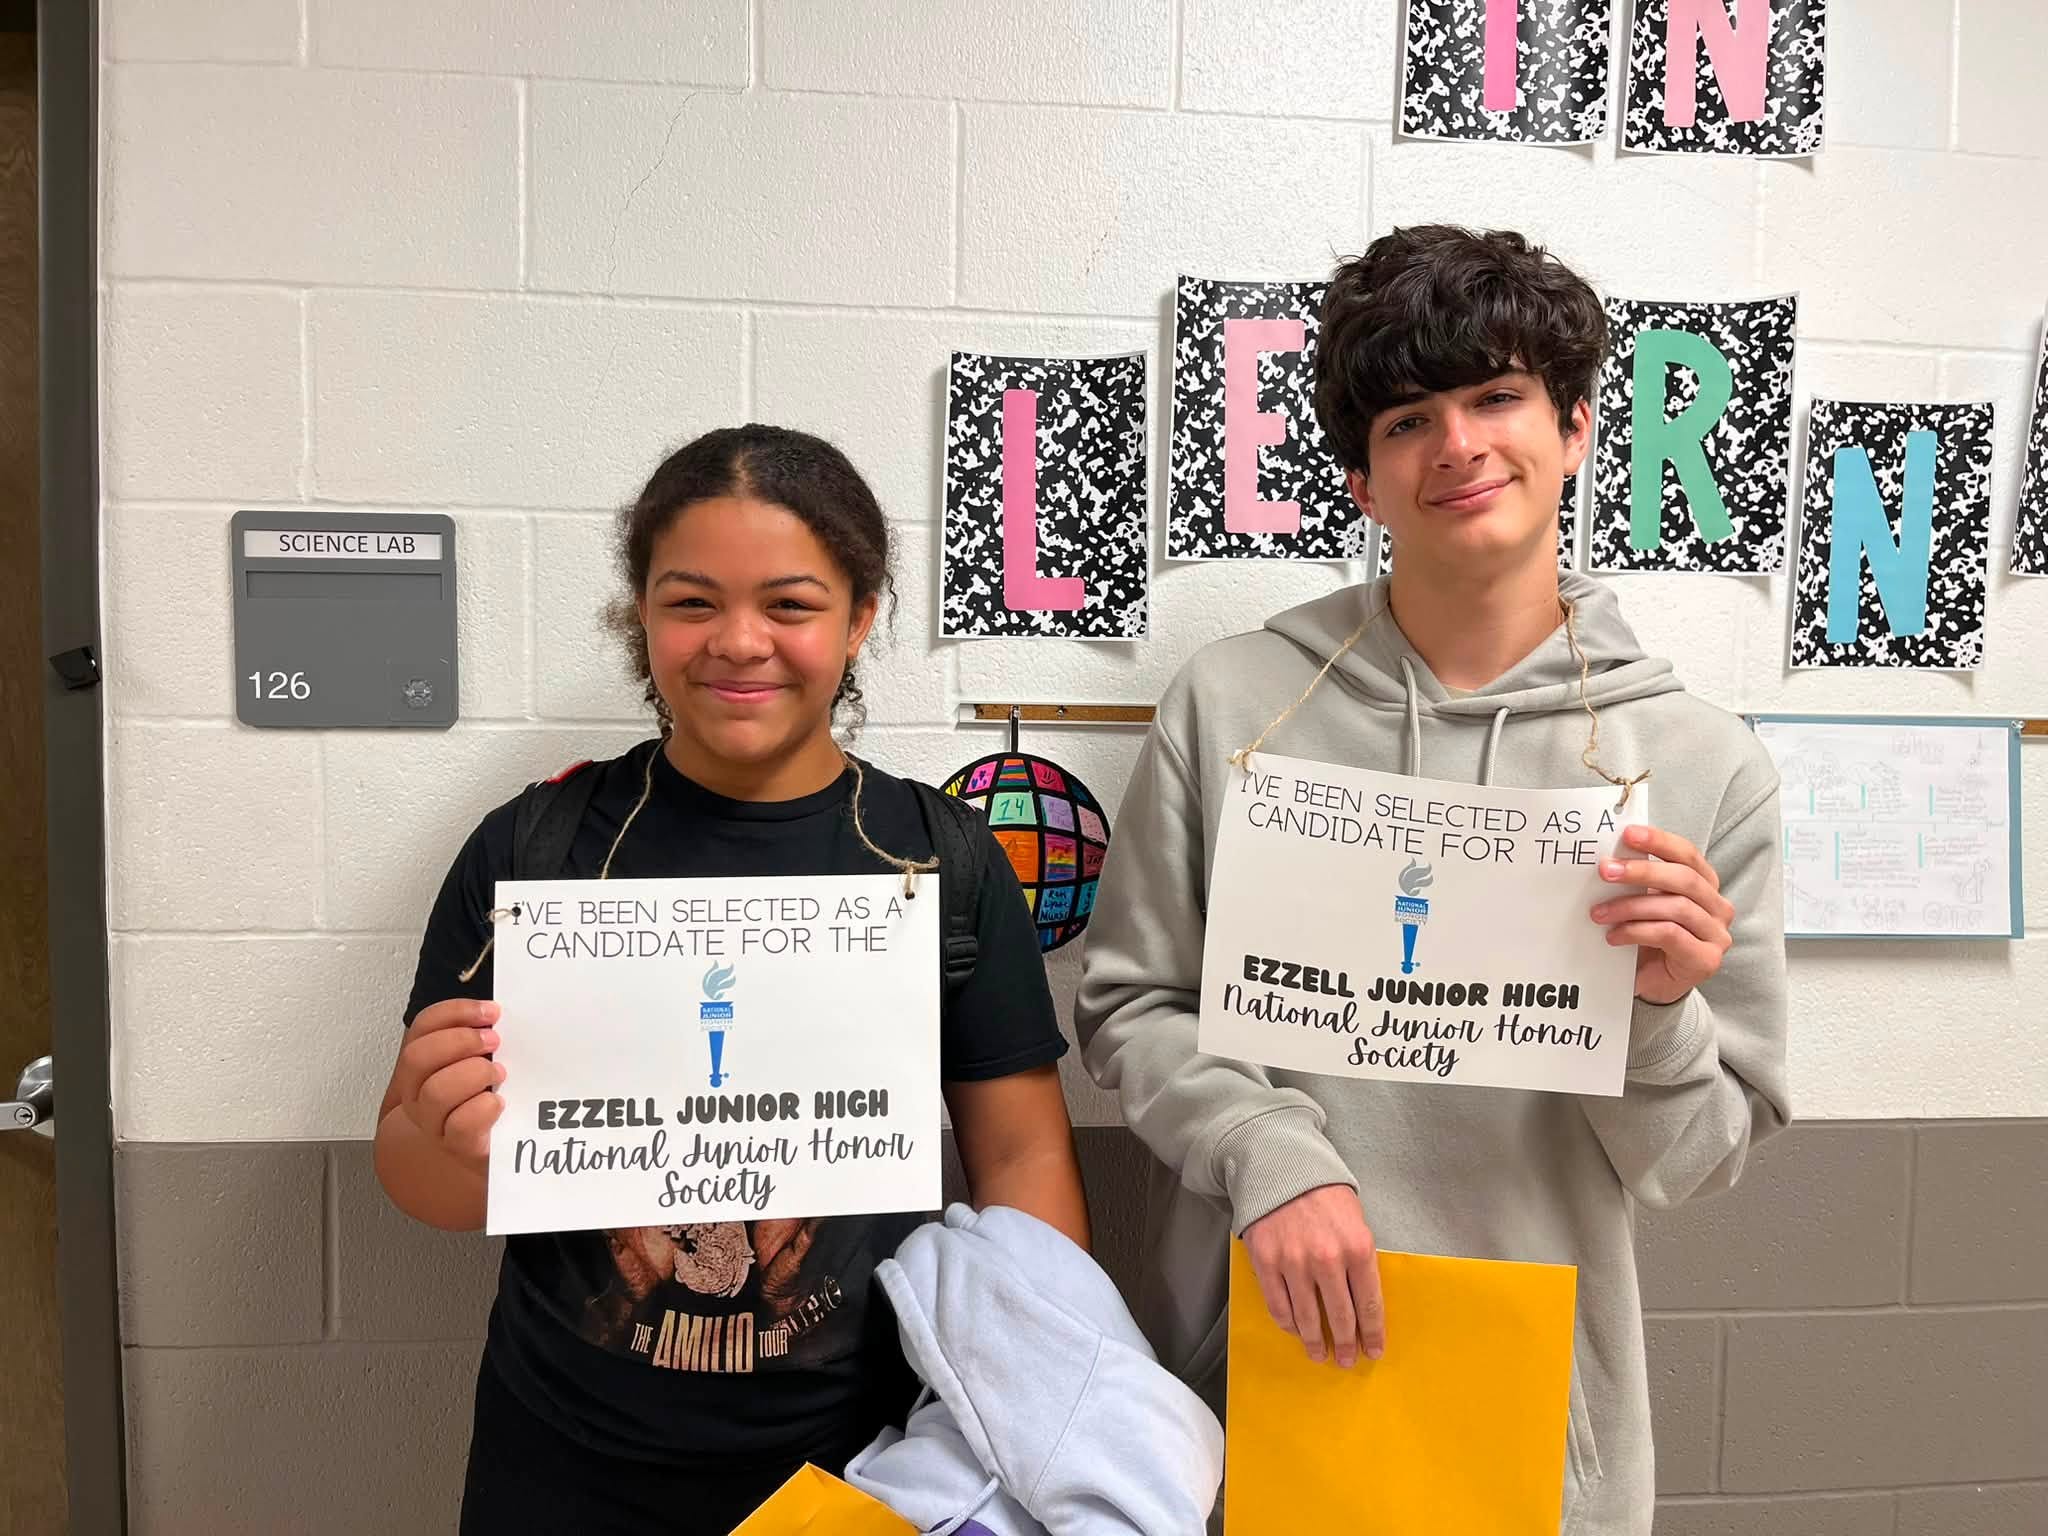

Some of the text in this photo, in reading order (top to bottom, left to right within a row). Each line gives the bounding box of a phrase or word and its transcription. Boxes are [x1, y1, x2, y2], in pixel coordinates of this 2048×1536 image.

[278, 533, 417, 554] SCIENCE LAB
[248, 670, 312, 701] 126
[1294, 779, 1362, 813] BEEN
[1374, 792, 1527, 833] SELECTED
[1543, 810, 1582, 834] AS
[1598, 808, 1615, 833] A
[1247, 802, 1598, 866] CANDIDATE FOR THE
[511, 896, 903, 926] I'VE BEEN SELECTED AS A
[526, 925, 888, 959] CANDIDATE FOR THE
[1243, 953, 1580, 1010] EZZELL JUNIOR HIGH
[1222, 984, 1603, 1051] National Junior Honor
[1347, 1037, 1461, 1078] Society
[537, 1088, 889, 1131] EZZELL JUNIOR HIGH
[514, 1127, 914, 1175] National Junior Honor
[658, 1168, 777, 1211] Society
[630, 1322, 654, 1354] THE
[758, 1329, 789, 1358] TOUR
